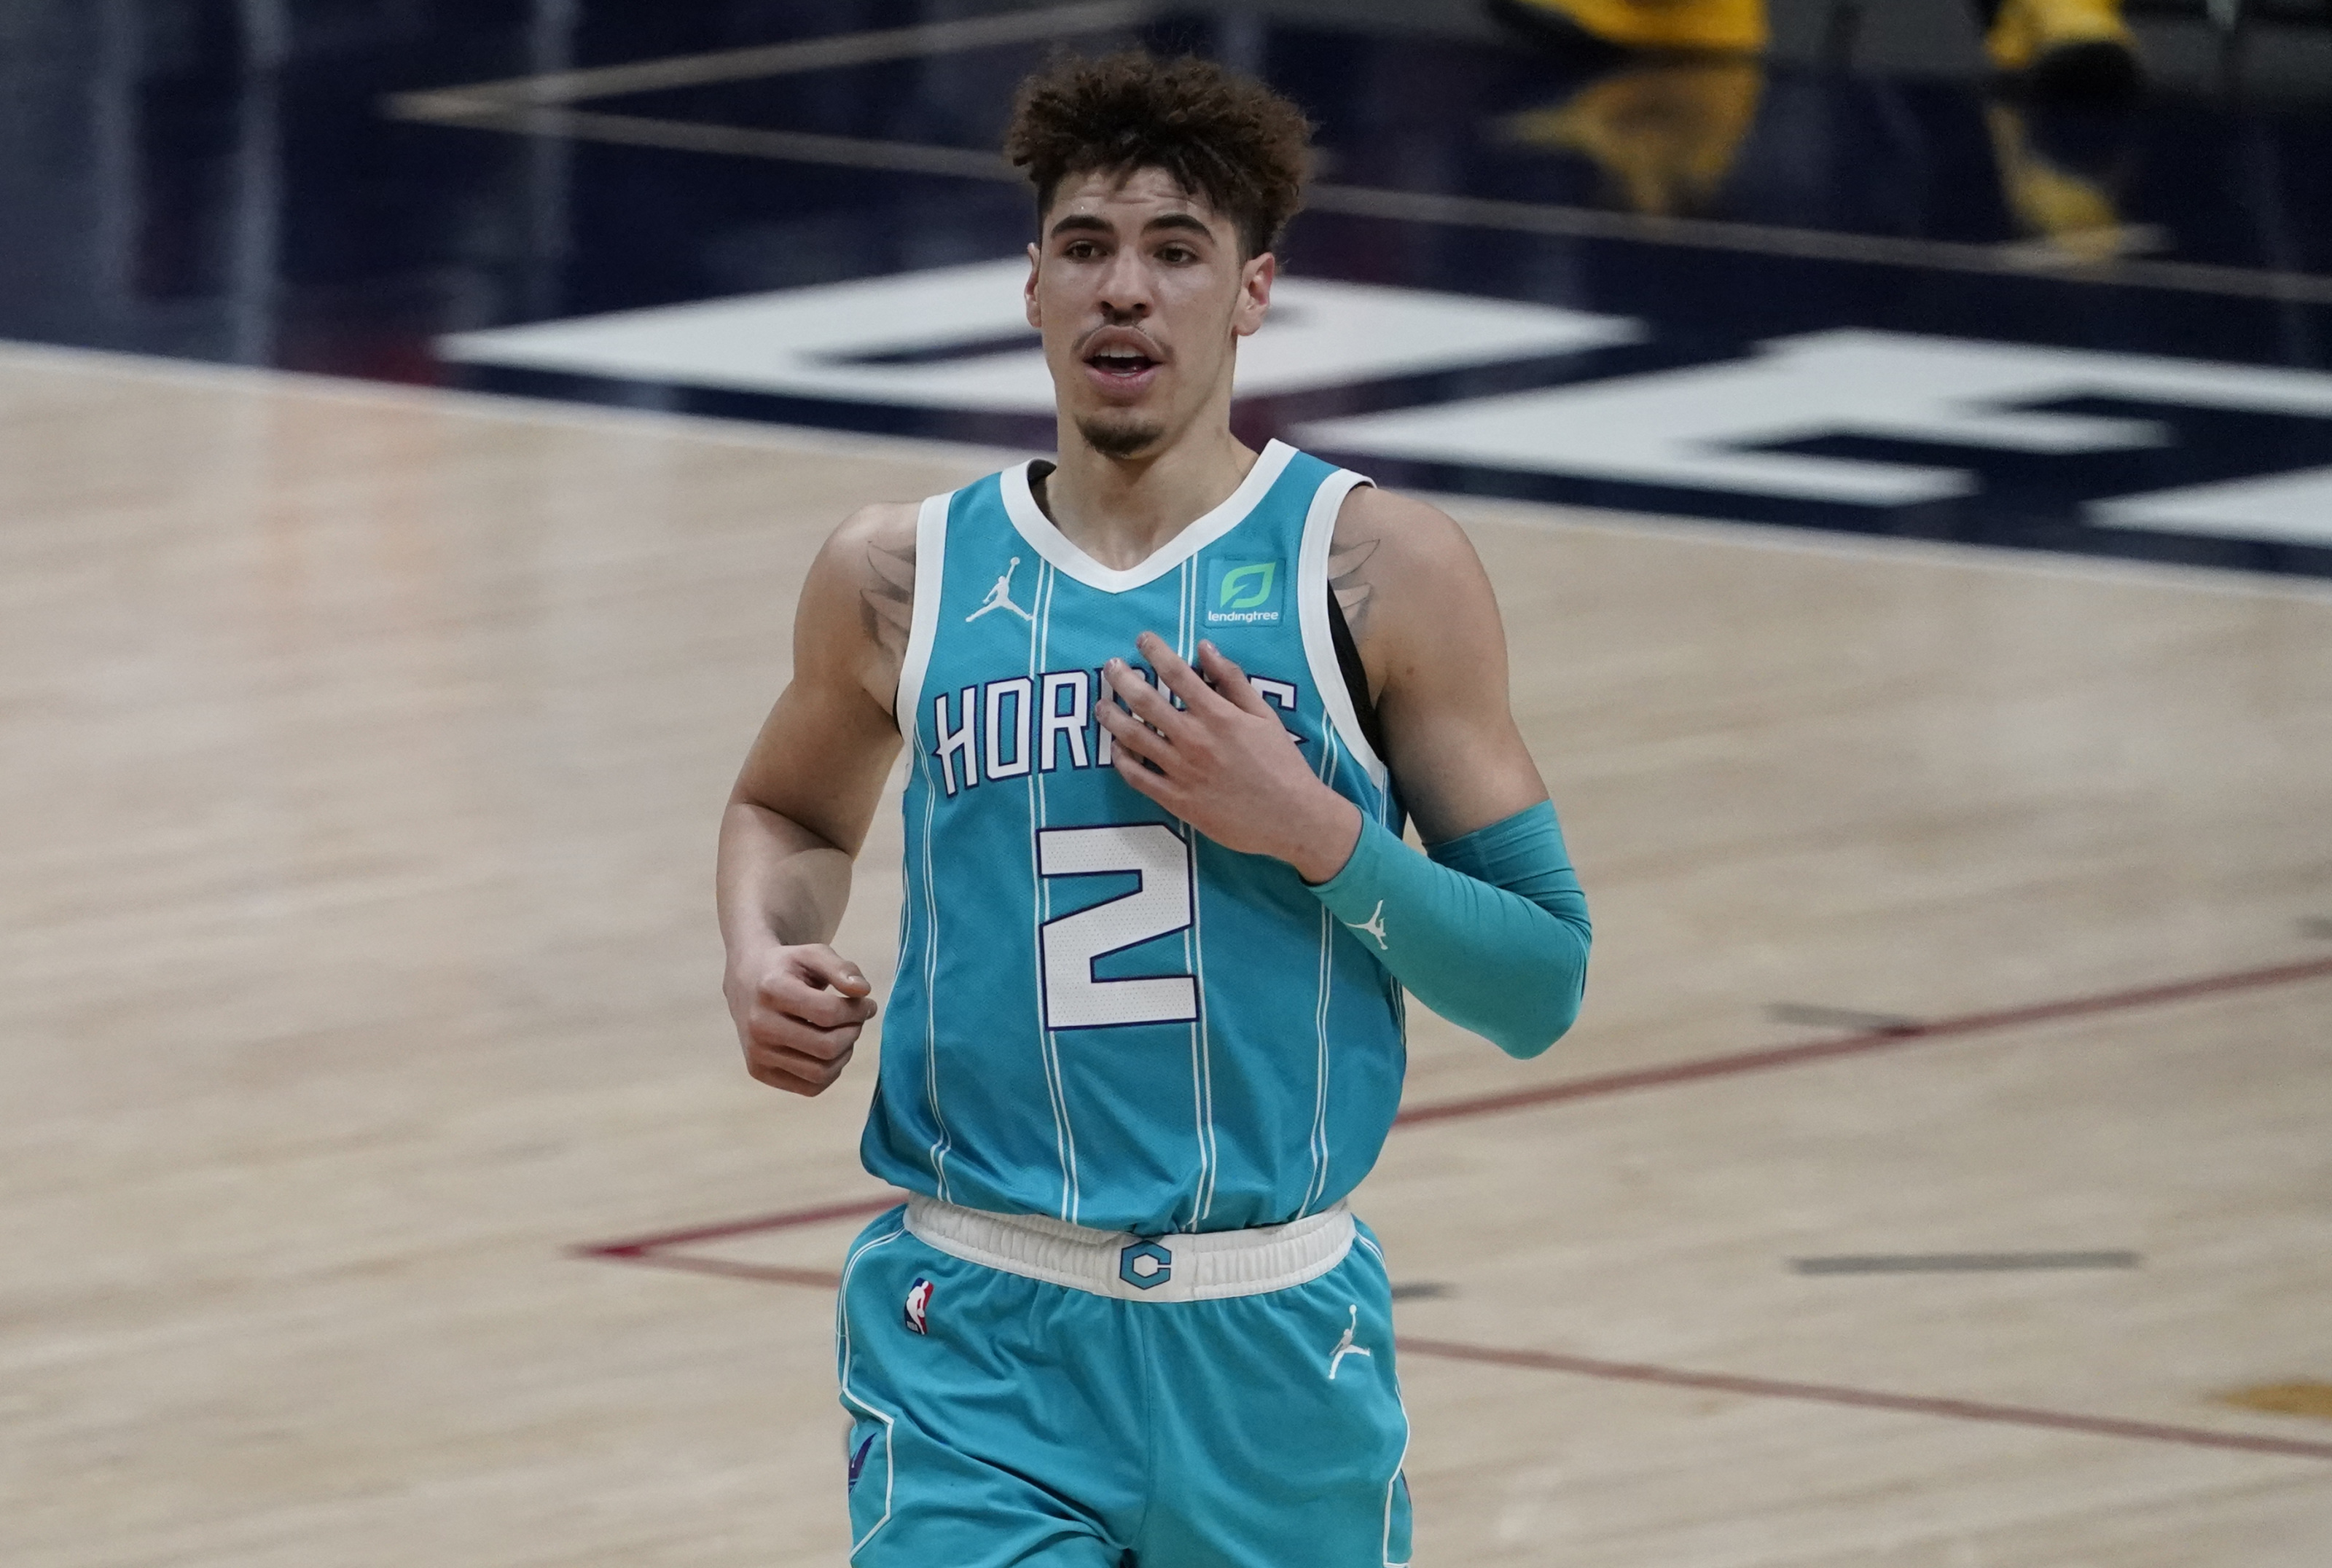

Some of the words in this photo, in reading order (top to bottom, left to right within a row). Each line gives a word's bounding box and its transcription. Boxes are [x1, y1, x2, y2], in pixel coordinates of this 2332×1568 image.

[1208, 611, 1279, 623] lendingtree
[1036, 821, 1200, 1032] 2
[1119, 1239, 1172, 1290] C
